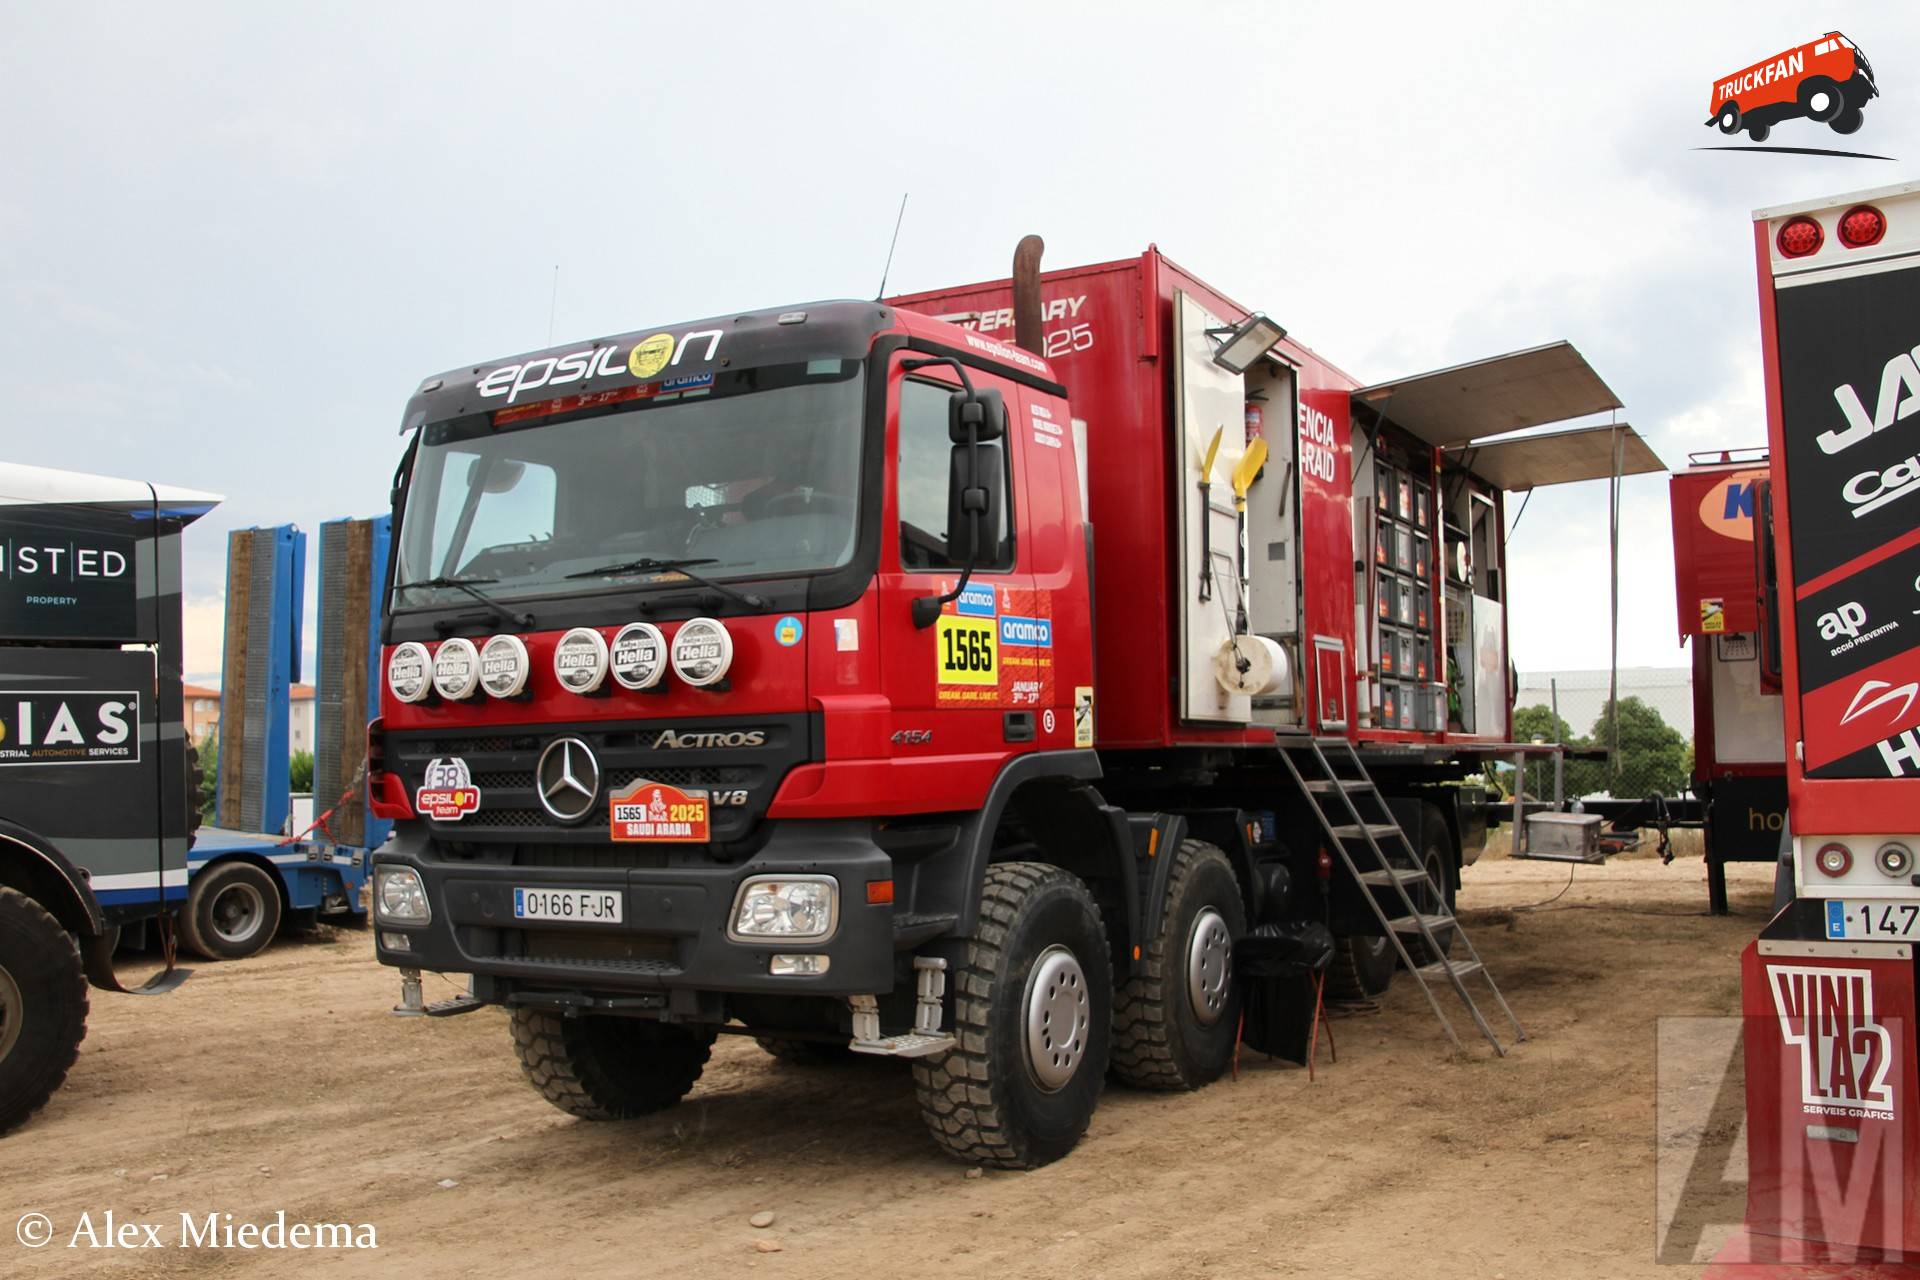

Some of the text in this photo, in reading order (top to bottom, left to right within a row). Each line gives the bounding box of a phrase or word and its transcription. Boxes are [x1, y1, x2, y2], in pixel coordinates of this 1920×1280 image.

[1816, 344, 1920, 455] JA
[26, 596, 78, 605] PROPERTY
[1816, 601, 1867, 642] ap
[1003, 621, 1049, 642] aramco
[1854, 621, 1900, 646] PREVENTIVA
[617, 648, 655, 664] Hella
[678, 644, 719, 660] Hella
[943, 628, 992, 672] 1565
[484, 659, 516, 674] Hella
[559, 653, 596, 668] Hella
[393, 665, 421, 680] Hella
[437, 662, 469, 677] Hella
[890, 729, 933, 745] 4154
[32, 749, 86, 757] AUTOMOTIVE
[89, 747, 129, 755] SERVICES
[1876, 725, 1920, 778] H
[435, 767, 459, 788] 38
[712, 790, 748, 805] V8
[617, 807, 641, 820] 1565
[669, 804, 705, 822] 2025
[627, 823, 692, 836] SAUDI ARABIA
[527, 893, 574, 916] 0166
[580, 895, 616, 918] FJR
[1832, 922, 1841, 932] E
[1803, 1105, 1847, 1116] SERVEIS
